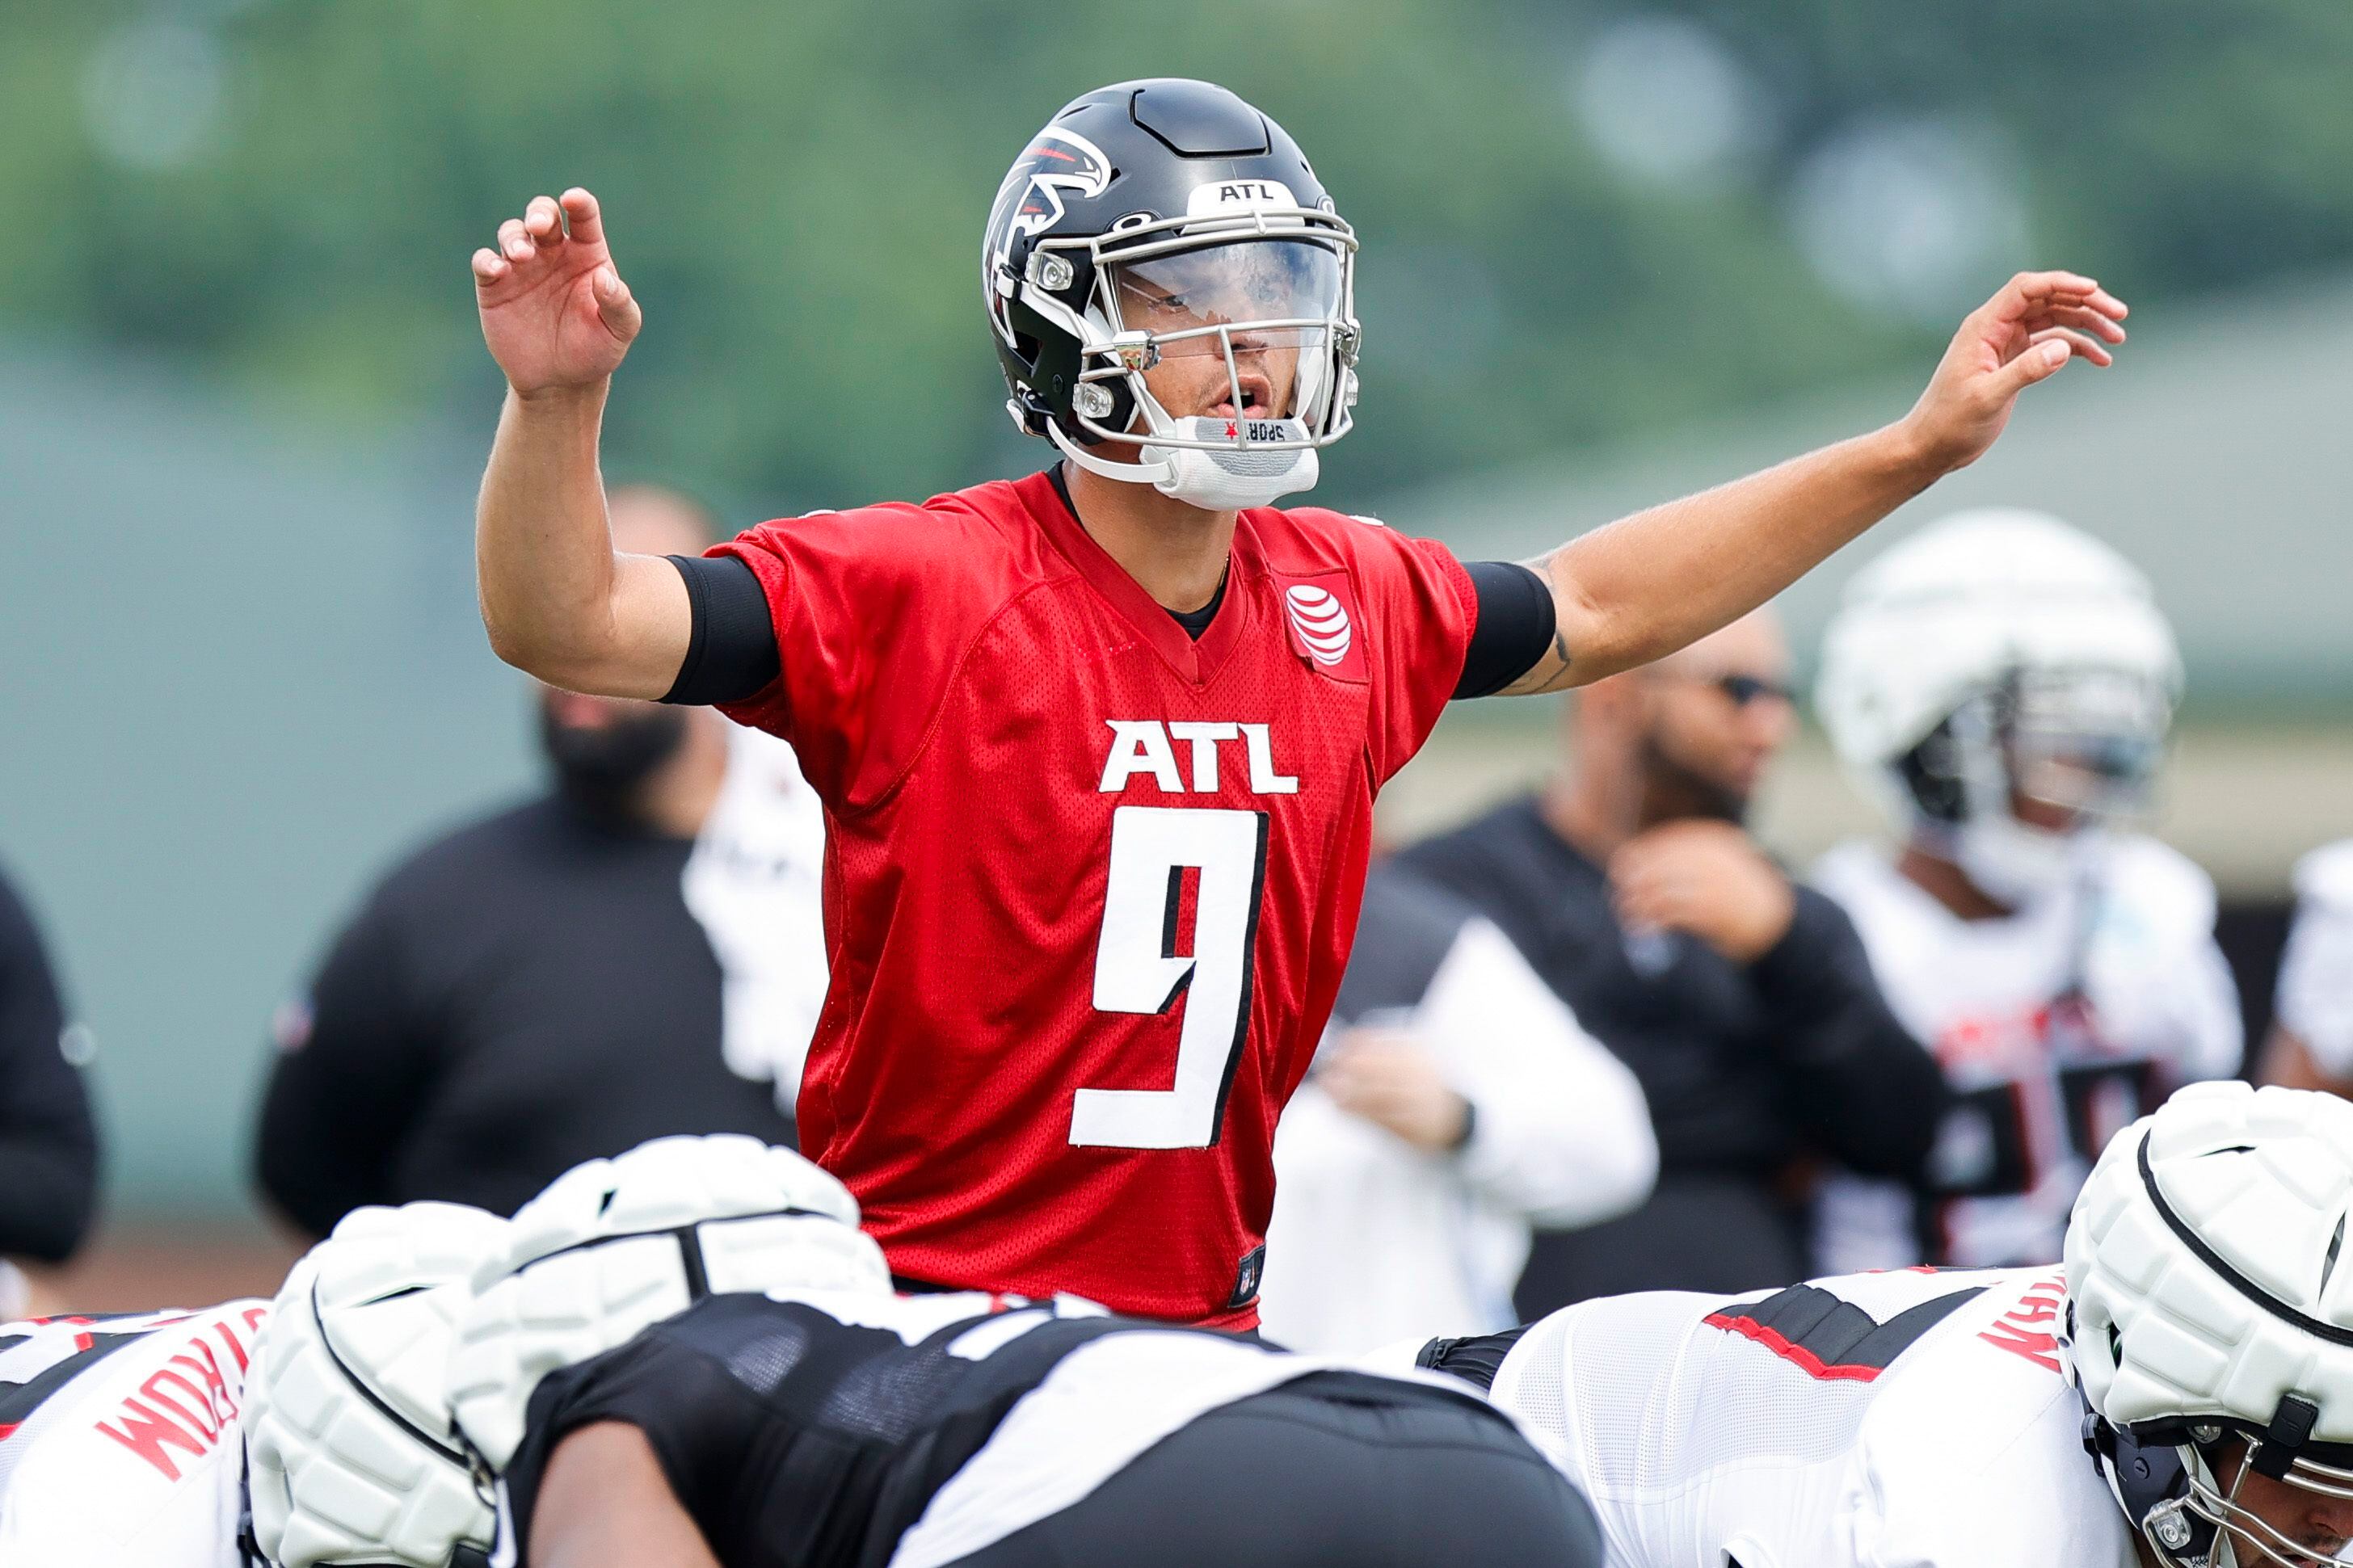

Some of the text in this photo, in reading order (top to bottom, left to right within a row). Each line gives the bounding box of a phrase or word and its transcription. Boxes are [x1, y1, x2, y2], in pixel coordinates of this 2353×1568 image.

[1219, 184, 1274, 202] ATL
[1245, 422, 1286, 442] SPOR
[1098, 719, 1299, 794] ATL
[1068, 805, 1269, 1150] 9
